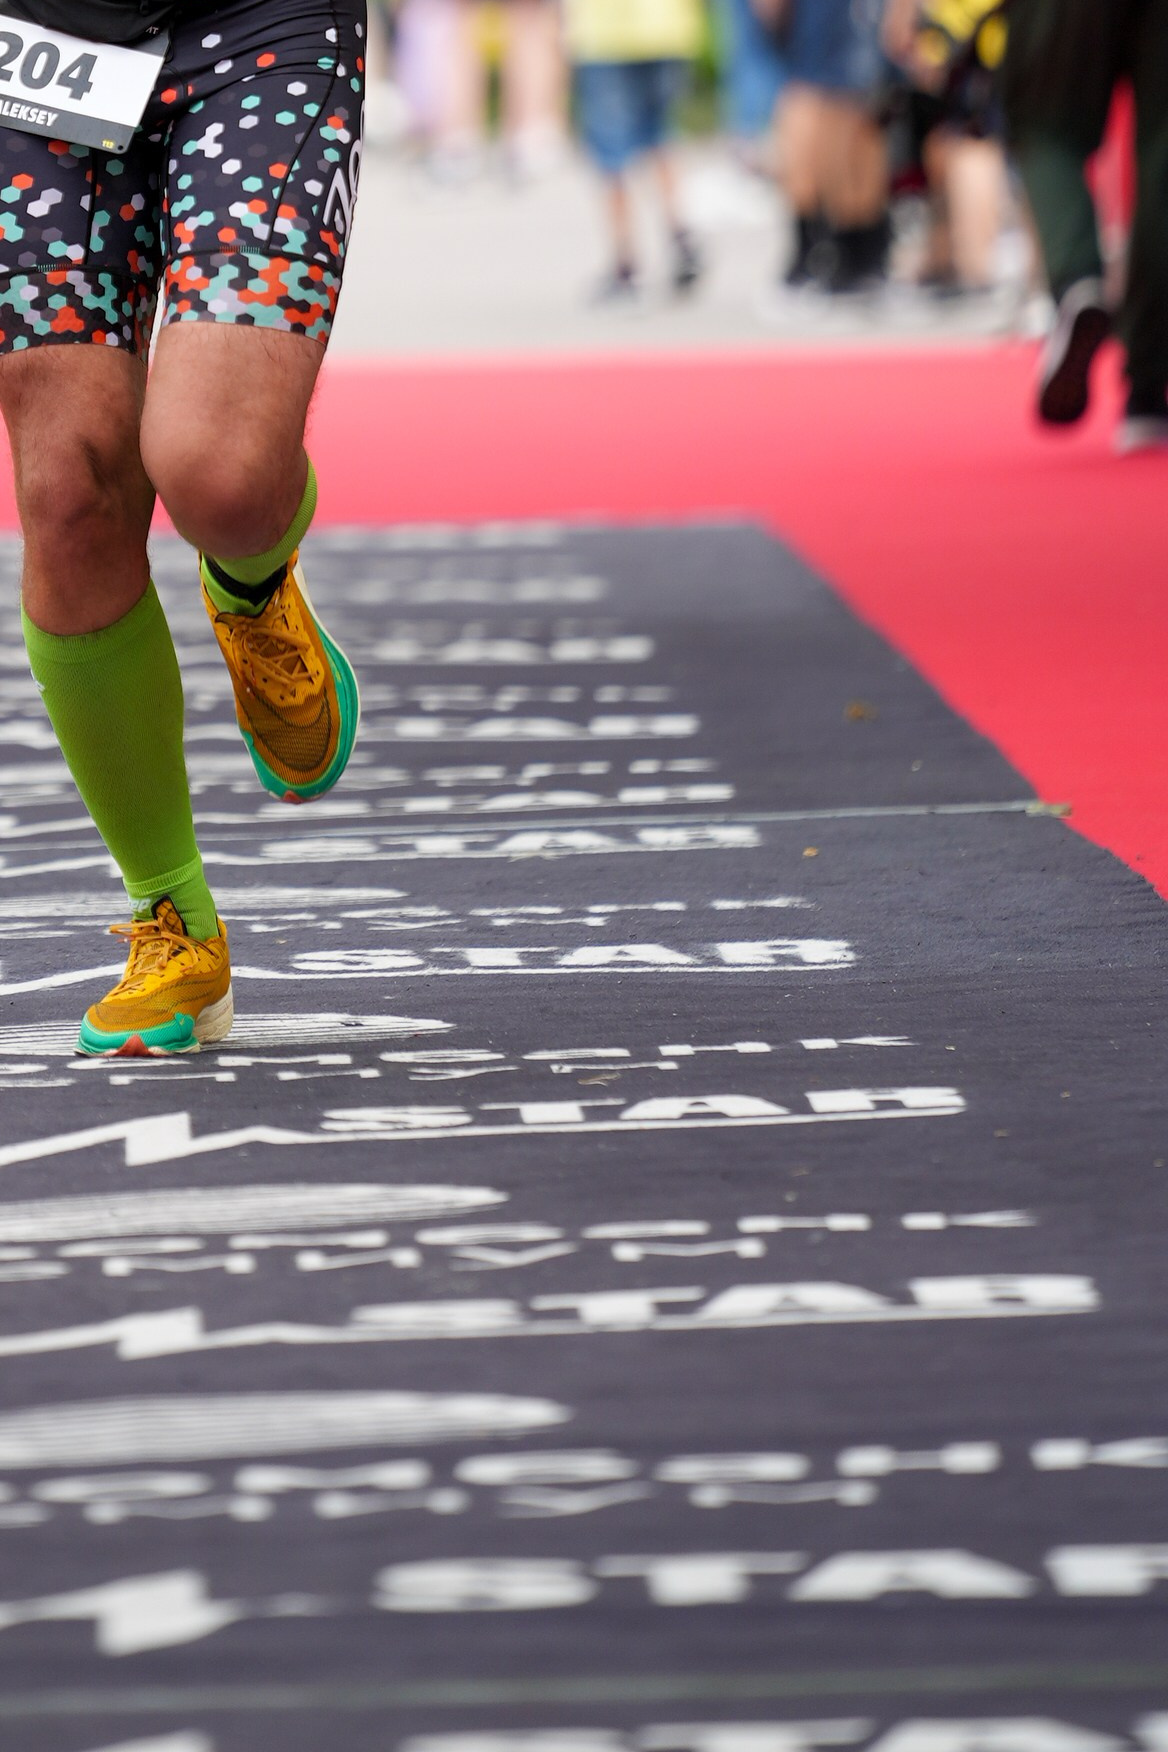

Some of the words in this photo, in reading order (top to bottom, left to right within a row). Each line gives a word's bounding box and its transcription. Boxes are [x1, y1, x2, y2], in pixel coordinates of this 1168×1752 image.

[289, 939, 855, 971] STAR
[320, 1086, 966, 1131] STAR
[352, 1274, 1096, 1330] STAR
